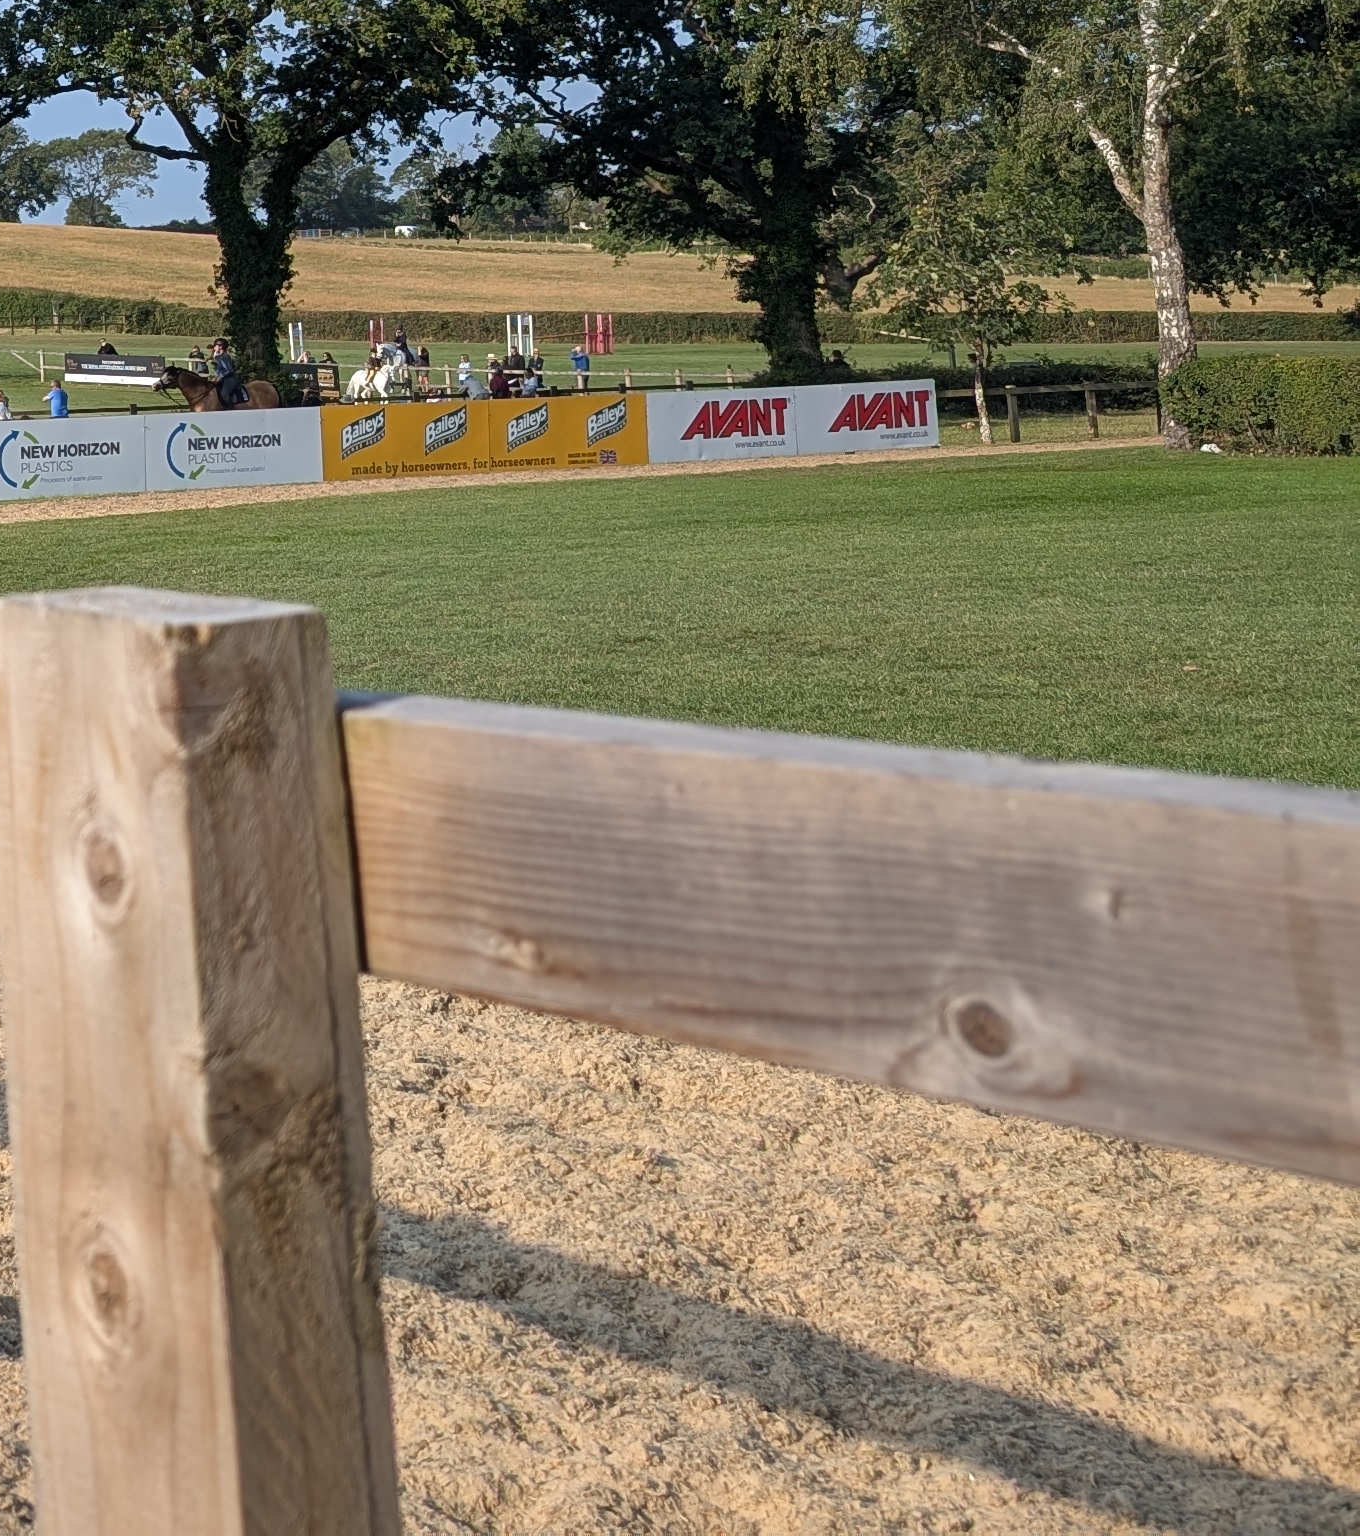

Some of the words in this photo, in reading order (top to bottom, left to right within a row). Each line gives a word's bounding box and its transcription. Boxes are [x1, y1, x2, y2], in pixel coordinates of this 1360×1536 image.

[342, 409, 384, 450] Baileys
[425, 407, 466, 447] Baileys
[507, 404, 547, 443] Baileys
[587, 400, 626, 438] Baileys
[680, 397, 788, 441] AVANT
[827, 389, 930, 434] AVANT
[20, 444, 55, 460] NEW
[57, 441, 121, 458] HORIZON
[187, 436, 220, 452] NEW
[222, 433, 282, 450] HORIZON
[188, 451, 238, 465] PLASTICS
[21, 460, 74, 474] PLASTICS
[351, 462, 383, 476] made
[385, 461, 399, 476] by
[401, 460, 471, 473] horseowners,
[473, 457, 489, 470] for
[490, 456, 556, 469] horseowners
